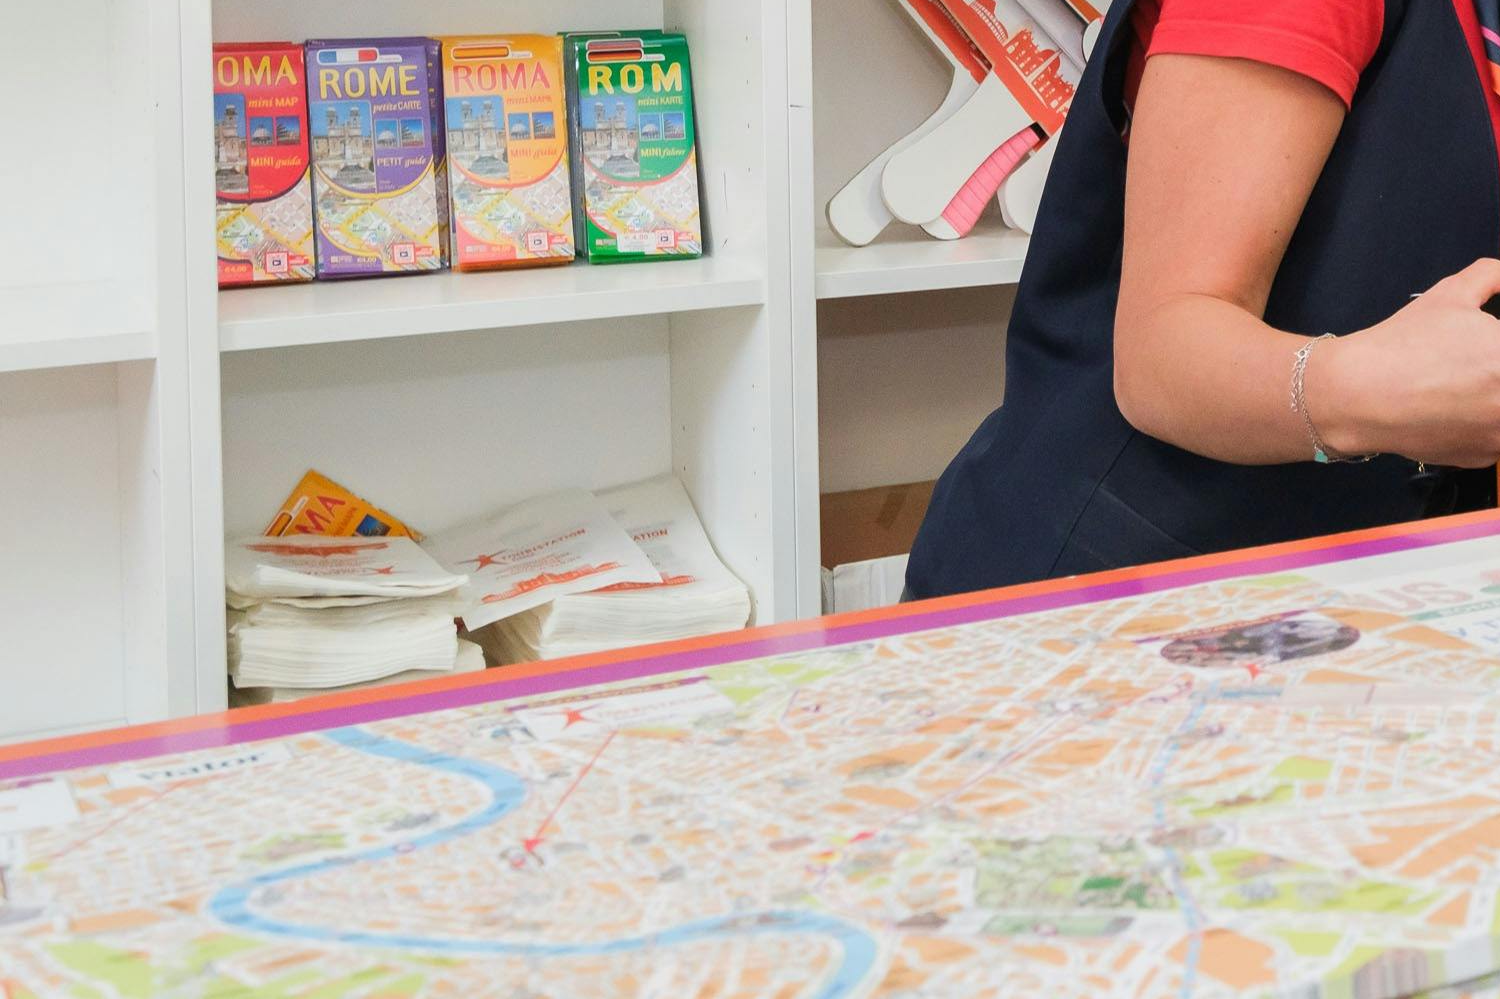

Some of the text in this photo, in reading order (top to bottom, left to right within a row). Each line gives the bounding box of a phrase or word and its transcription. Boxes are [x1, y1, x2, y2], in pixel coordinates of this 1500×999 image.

[217, 55, 298, 87] OMA
[319, 65, 420, 100] ROME
[452, 61, 551, 93] ROMA
[588, 62, 683, 95] ROM
[274, 96, 299, 107] MAP
[250, 157, 274, 167] MINI
[295, 495, 346, 534] MA
